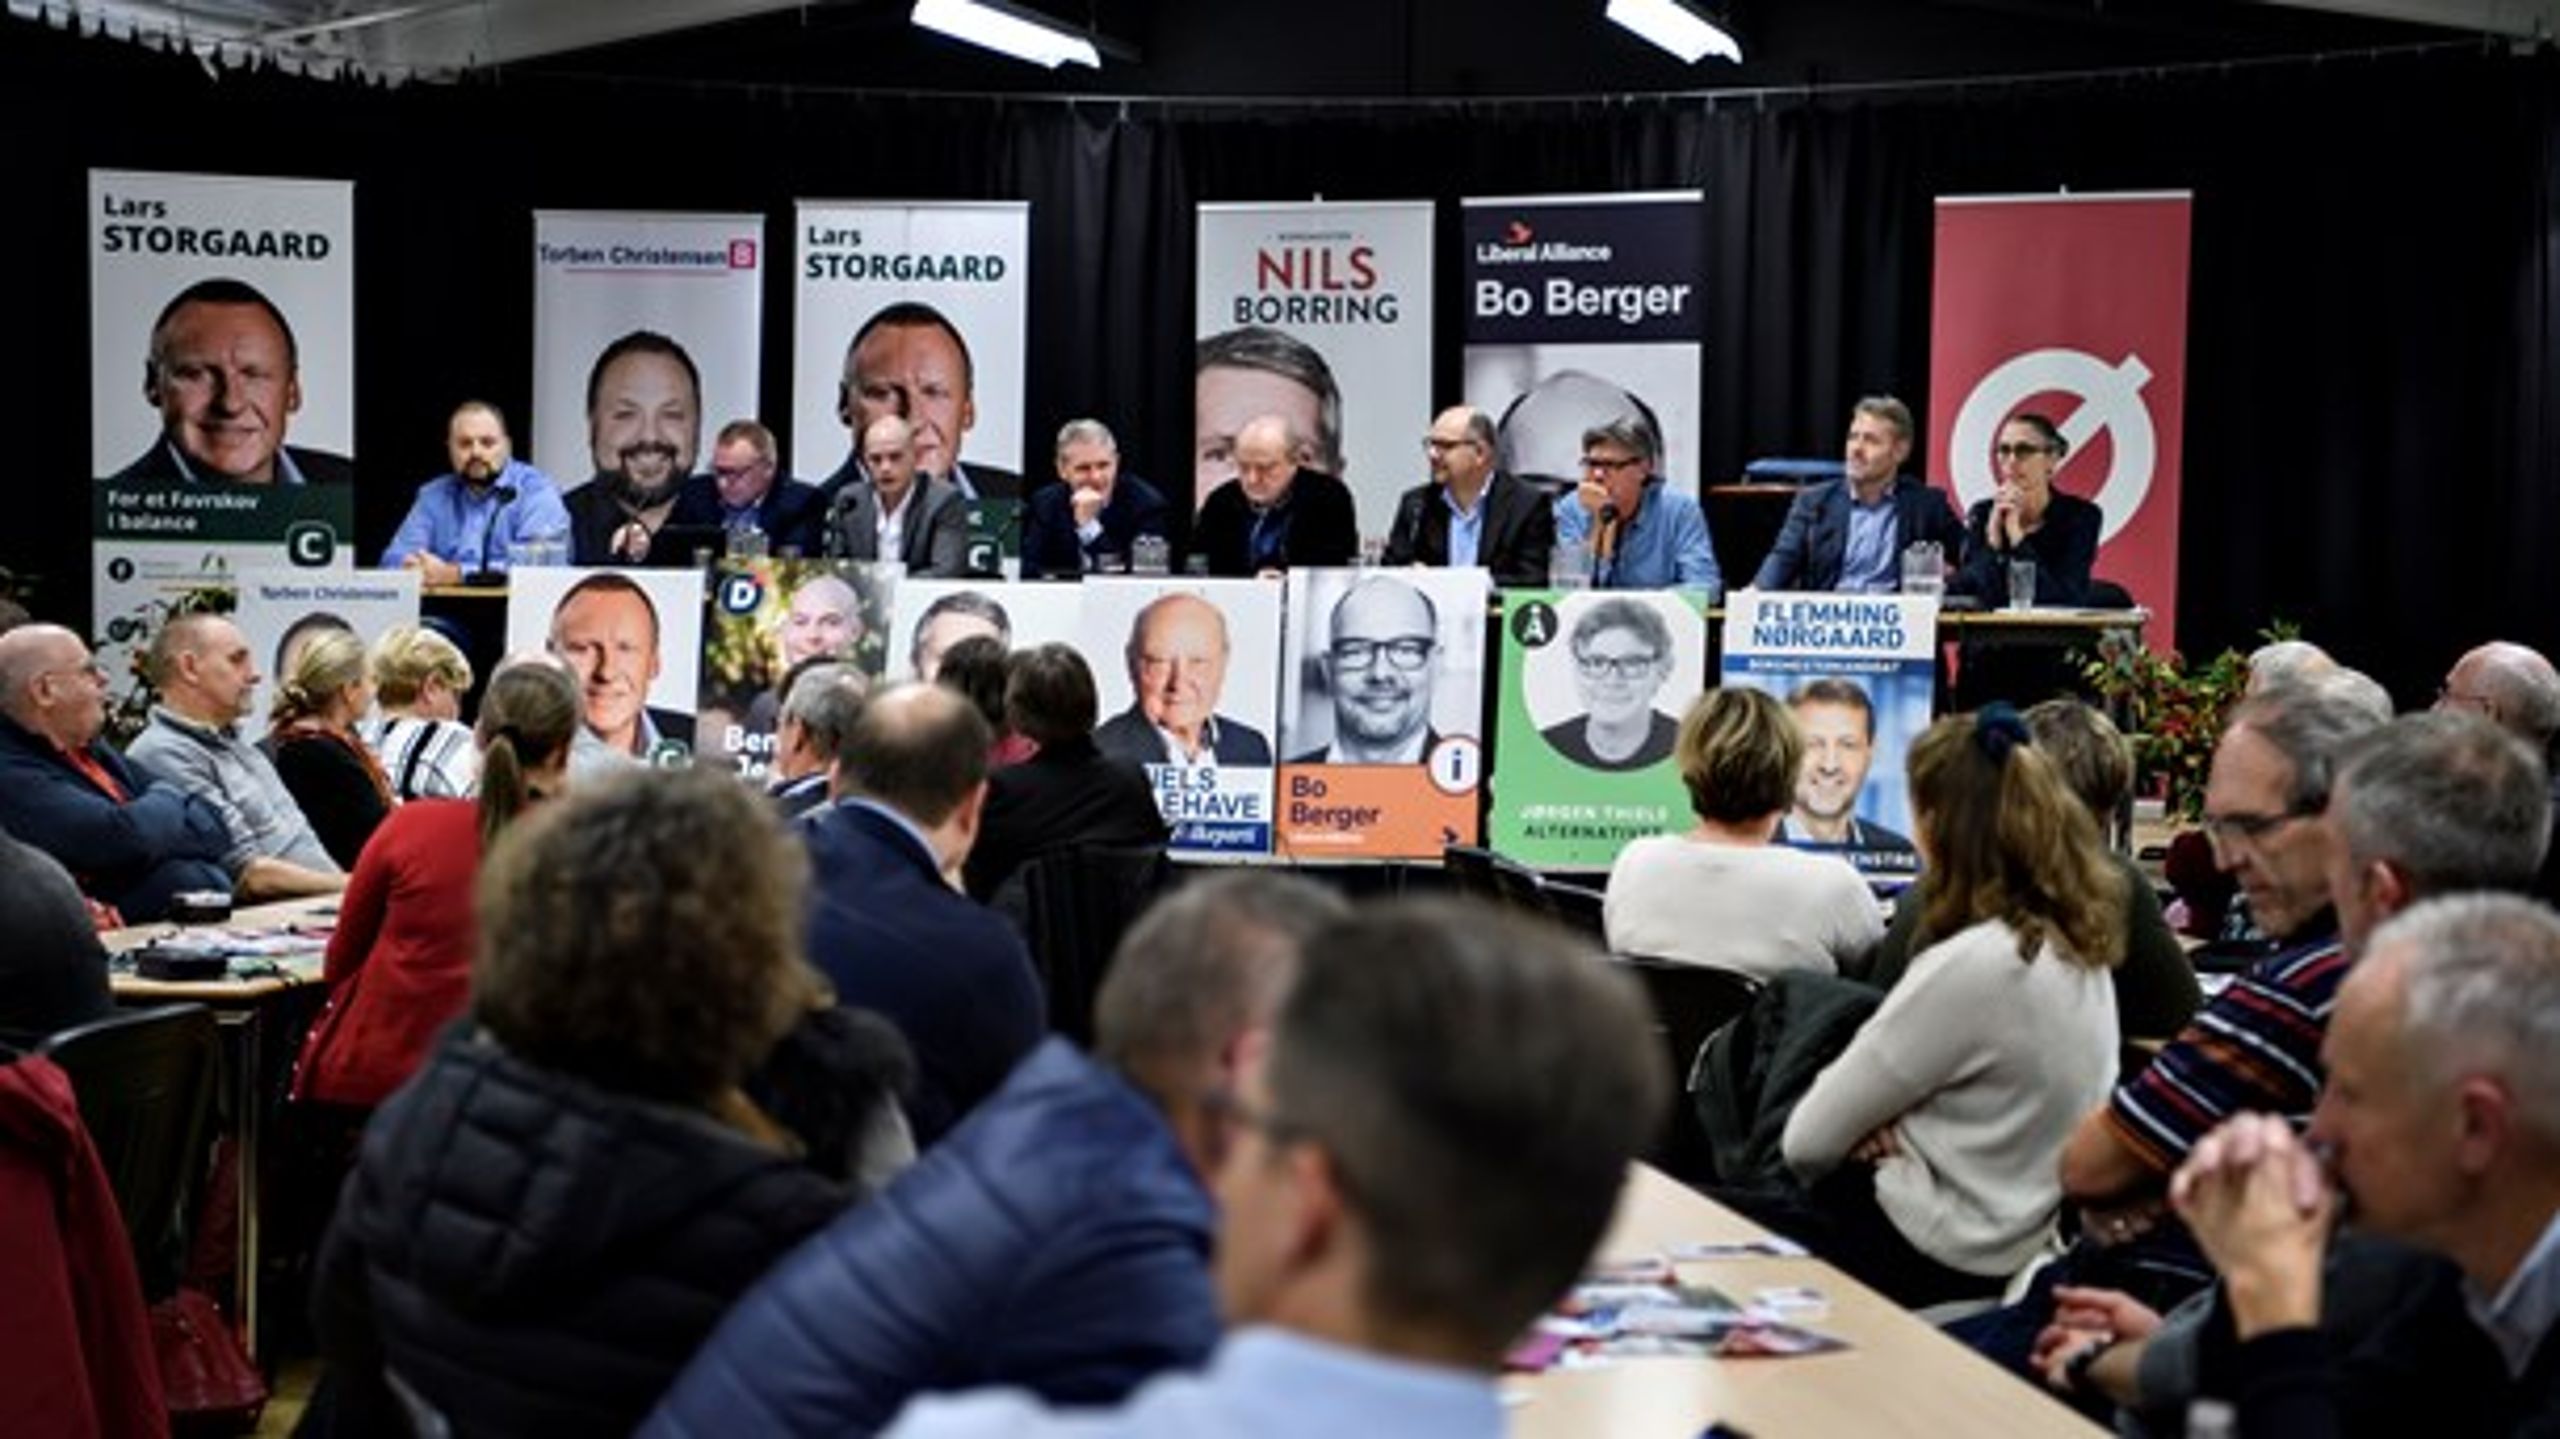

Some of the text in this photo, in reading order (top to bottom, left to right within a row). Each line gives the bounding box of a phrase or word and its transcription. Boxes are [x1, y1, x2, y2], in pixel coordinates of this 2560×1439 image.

[103, 195, 168, 219] Lars
[103, 225, 331, 260] STORGAARD
[807, 226, 862, 248] Lars
[539, 244, 605, 264] Torben
[609, 246, 727, 266] Christensen
[1476, 243, 1612, 262] Liberal Alliance
[806, 255, 1006, 282] STORGAARD
[1258, 246, 1377, 291] NILS
[1234, 294, 1399, 324] BORRING
[1476, 278, 1691, 324] Bo Berger
[108, 490, 139, 507] For
[145, 492, 166, 509] et
[118, 512, 198, 531] balance
[729, 585, 756, 610] D
[1757, 602, 1900, 626] FLEMMING
[1753, 625, 1905, 650] NØRGAARD
[1291, 776, 1327, 798] Bo
[1290, 802, 1380, 830] Berger
